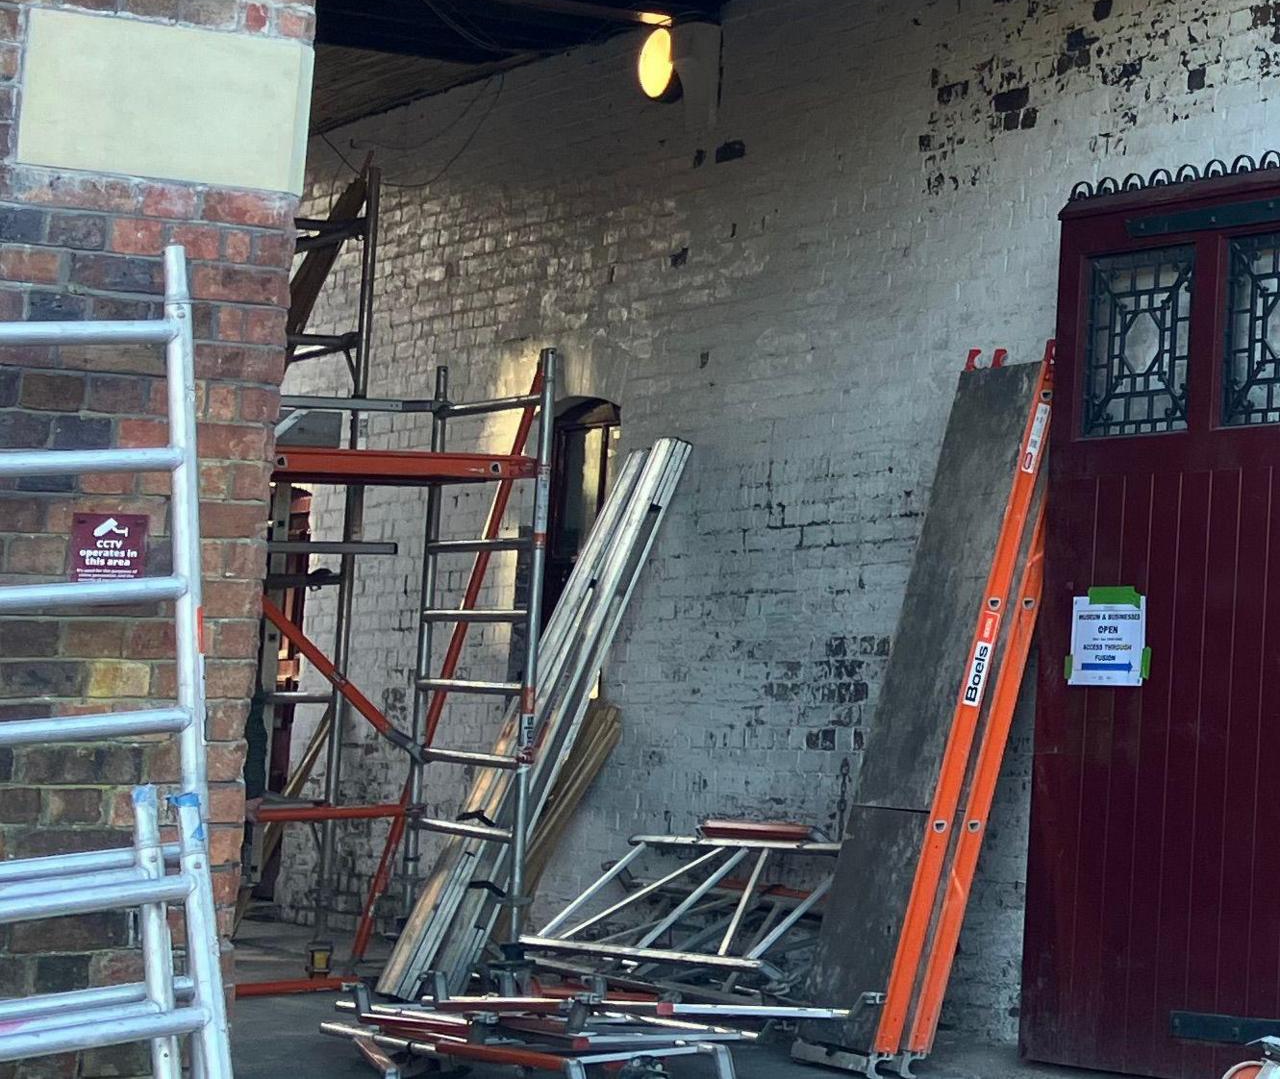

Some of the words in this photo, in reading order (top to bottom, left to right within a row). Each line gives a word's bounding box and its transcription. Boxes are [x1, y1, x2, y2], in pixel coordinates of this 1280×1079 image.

[96, 540, 123, 548] CCTV
[79, 550, 125, 559] operates
[127, 549, 138, 557] in
[85, 558, 105, 566] this
[965, 646, 988, 702] Boels
